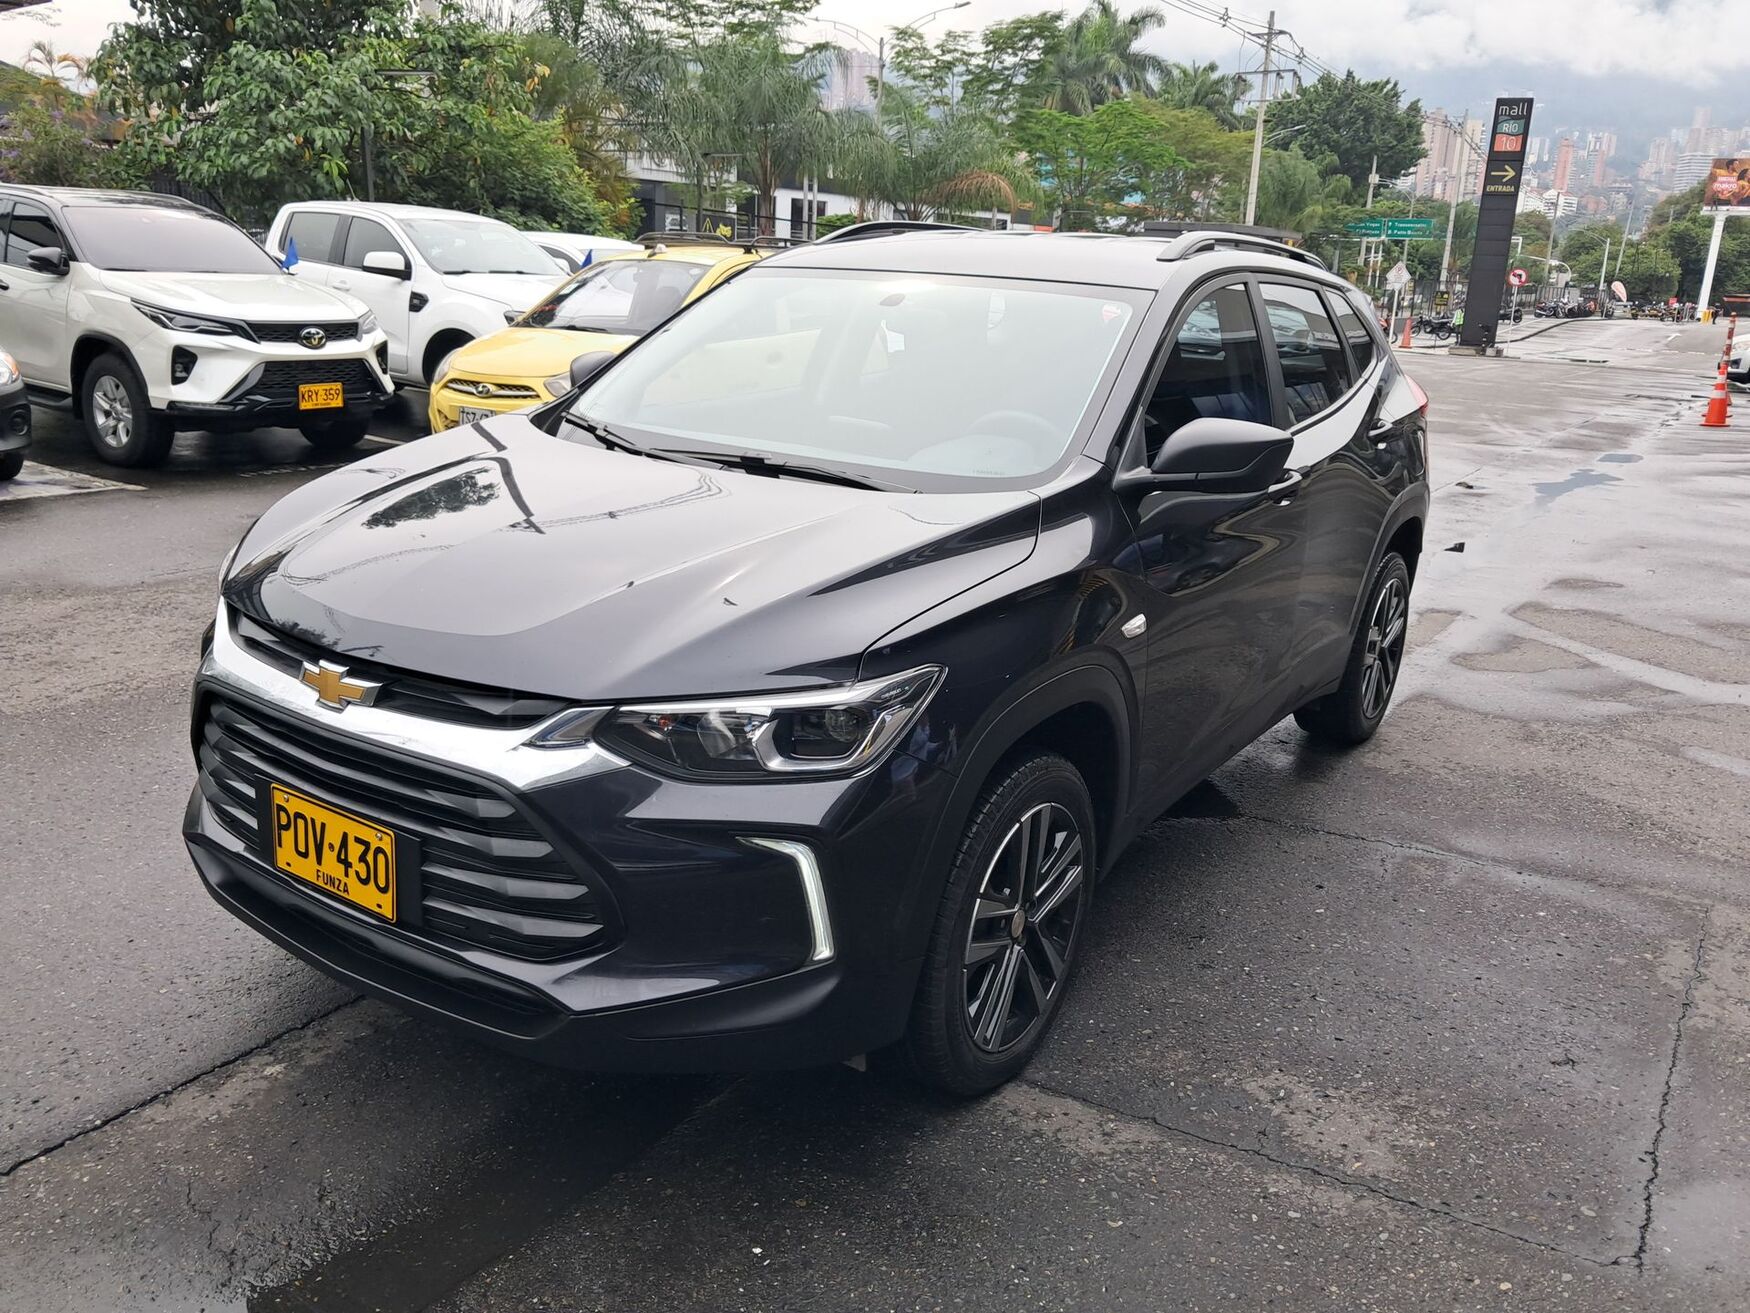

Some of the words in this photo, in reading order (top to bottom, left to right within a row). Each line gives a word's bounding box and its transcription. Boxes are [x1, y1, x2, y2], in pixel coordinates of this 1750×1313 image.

[1499, 102, 1528, 116] mall
[1501, 136, 1516, 150] 10
[316, 869, 350, 896] FUNZA
